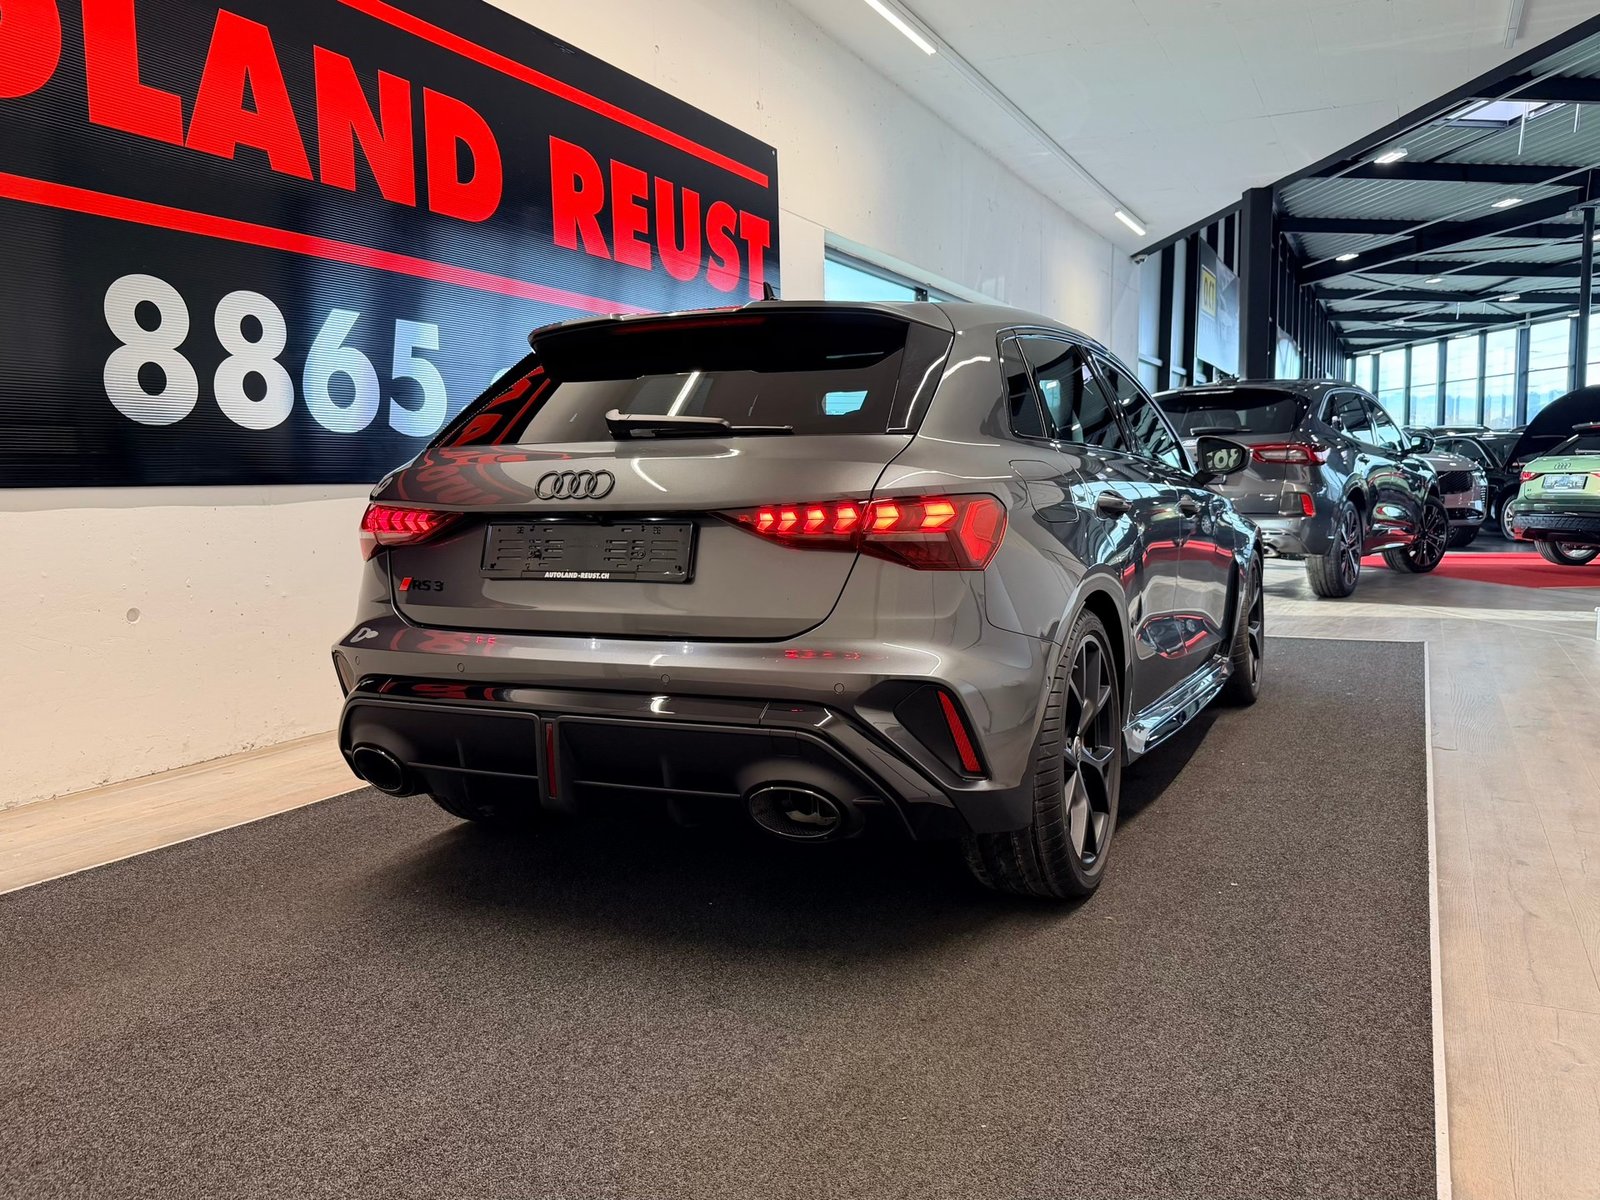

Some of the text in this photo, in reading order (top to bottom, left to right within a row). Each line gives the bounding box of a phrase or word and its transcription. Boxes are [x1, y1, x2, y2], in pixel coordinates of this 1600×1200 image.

[549, 135, 771, 301] REUST
[103, 273, 448, 438] 8865
[544, 571, 610, 579] AUTOLAND-REUST.CH
